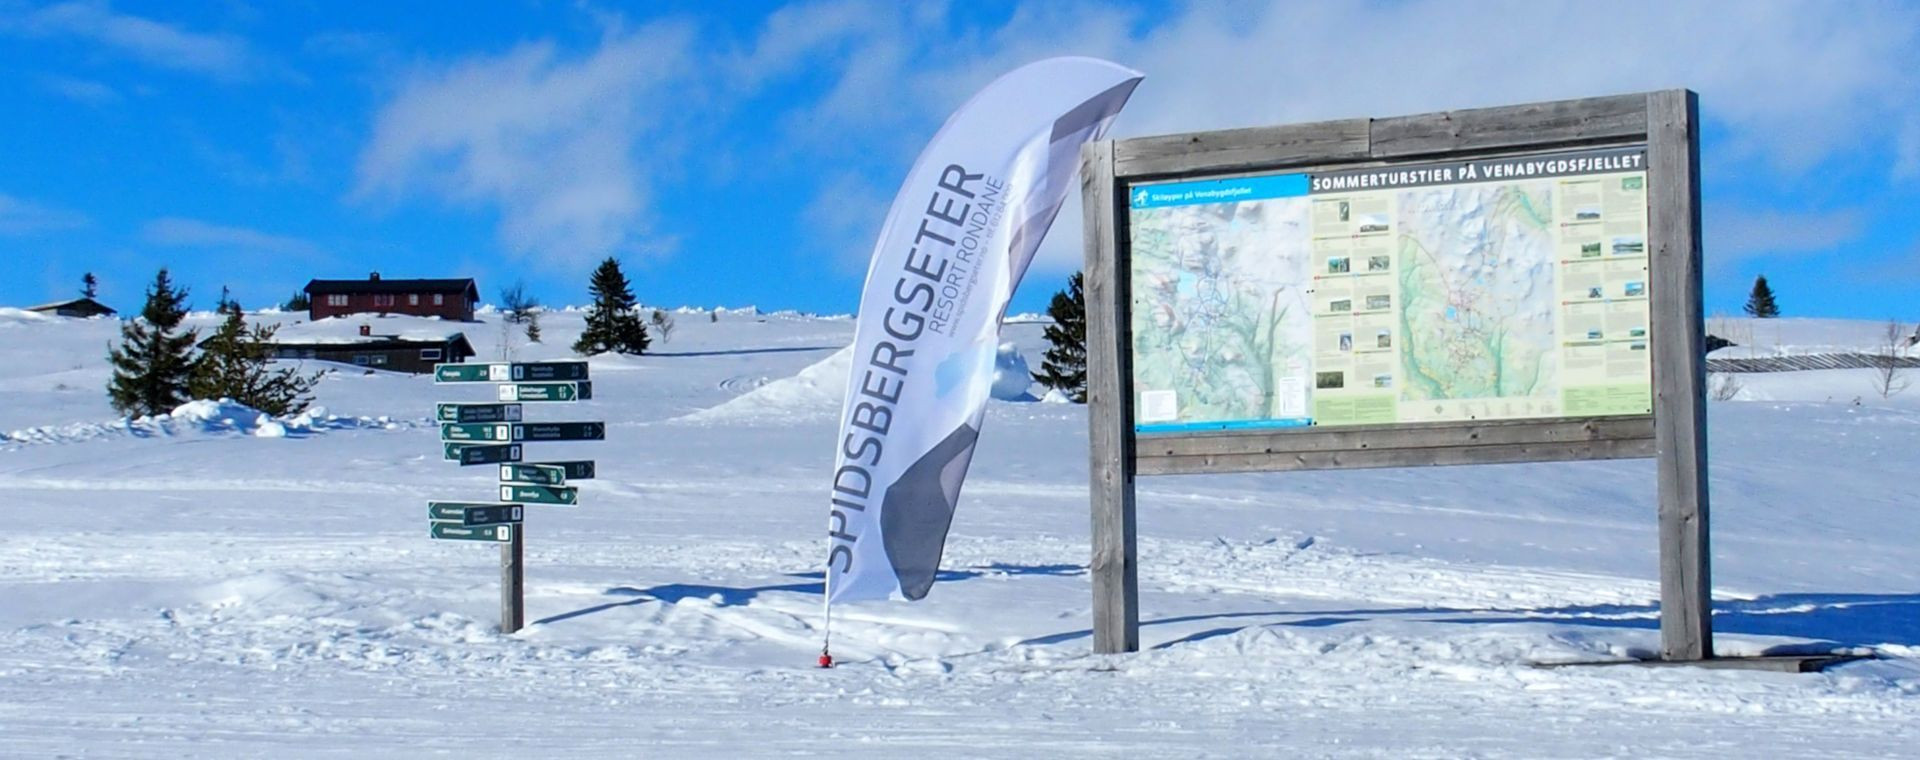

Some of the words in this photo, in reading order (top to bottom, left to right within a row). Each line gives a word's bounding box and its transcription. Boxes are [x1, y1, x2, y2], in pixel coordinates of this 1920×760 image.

[1312, 169, 1452, 191] SOMMERTURSTIER
[1458, 163, 1478, 180] PÅ
[1483, 154, 1642, 178] VENABYGDSFJELLET
[929, 262, 967, 334] RESORT
[956, 175, 1004, 264] RONDANE
[828, 164, 984, 574] SPIDSBERGSETER
